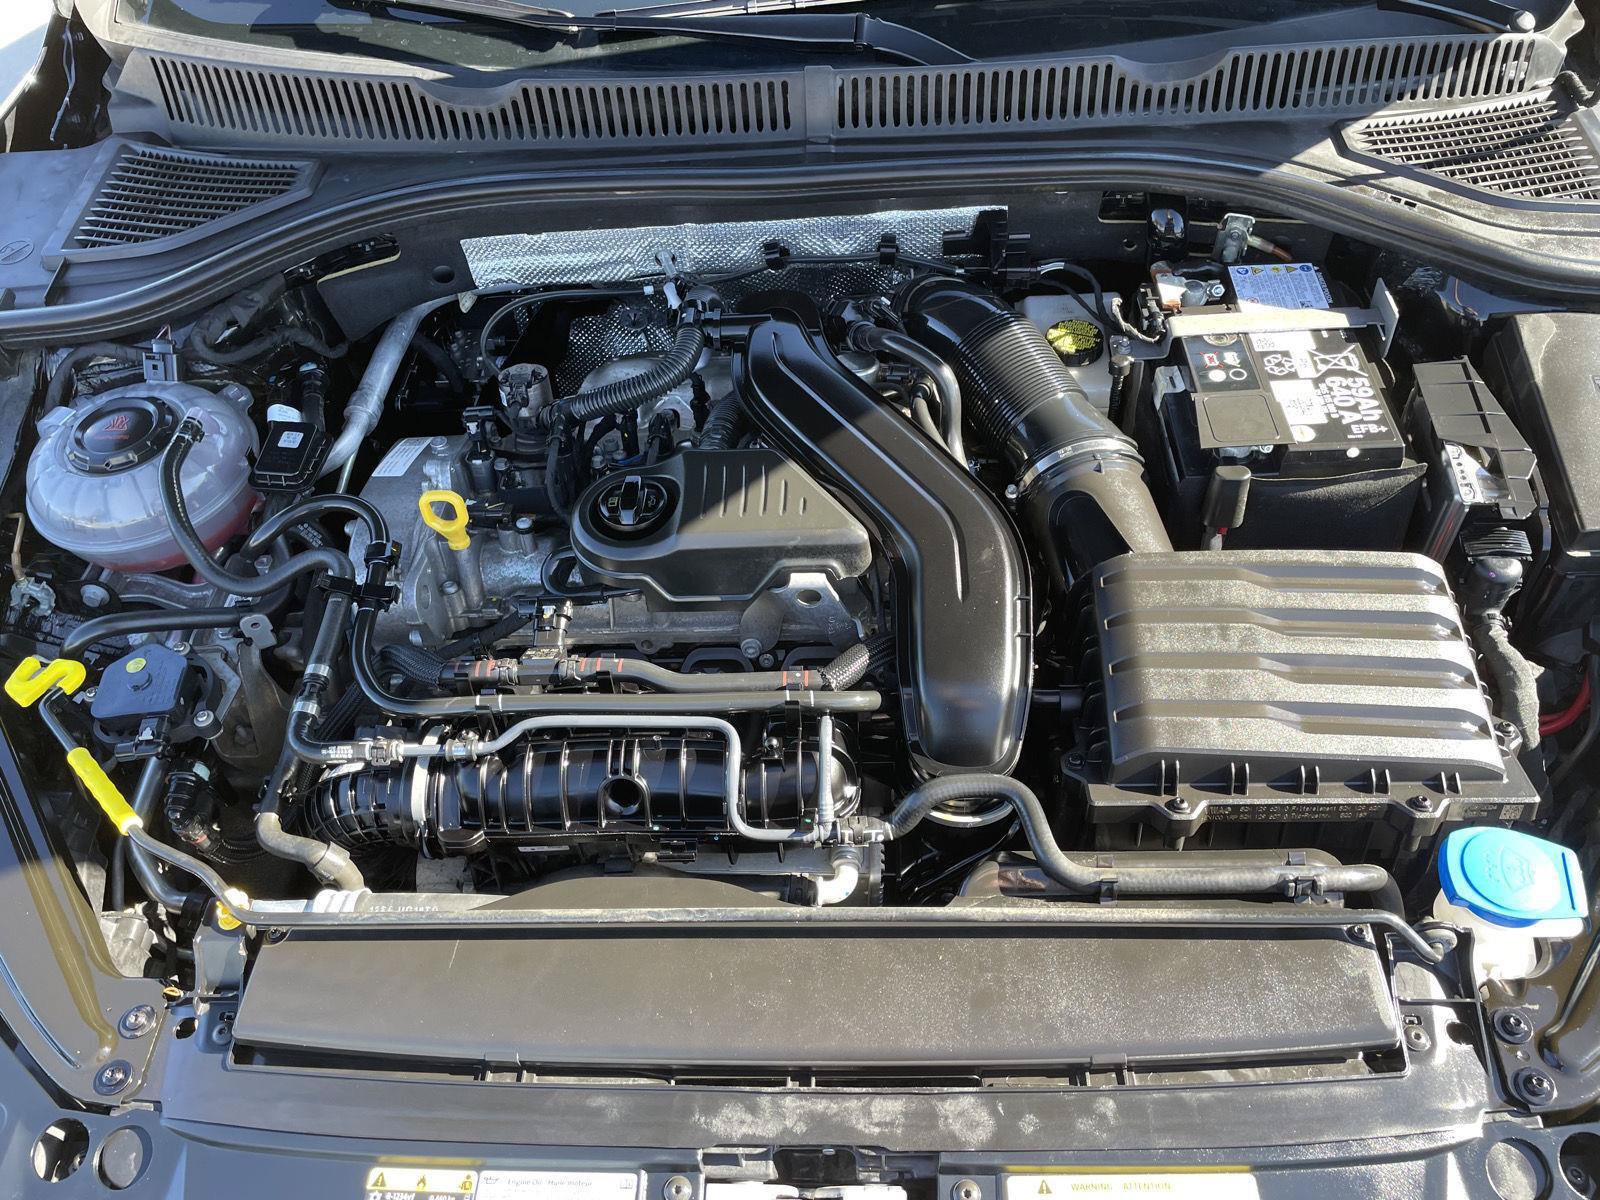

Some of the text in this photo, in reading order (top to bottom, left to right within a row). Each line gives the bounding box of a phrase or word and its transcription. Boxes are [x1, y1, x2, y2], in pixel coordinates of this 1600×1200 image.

[1325, 376, 1357, 407] 640
[1347, 377, 1383, 421] 59Ah
[1338, 409, 1363, 425] A
[1350, 423, 1388, 434] EFB+
[1071, 1182, 1113, 1191] WARNING
